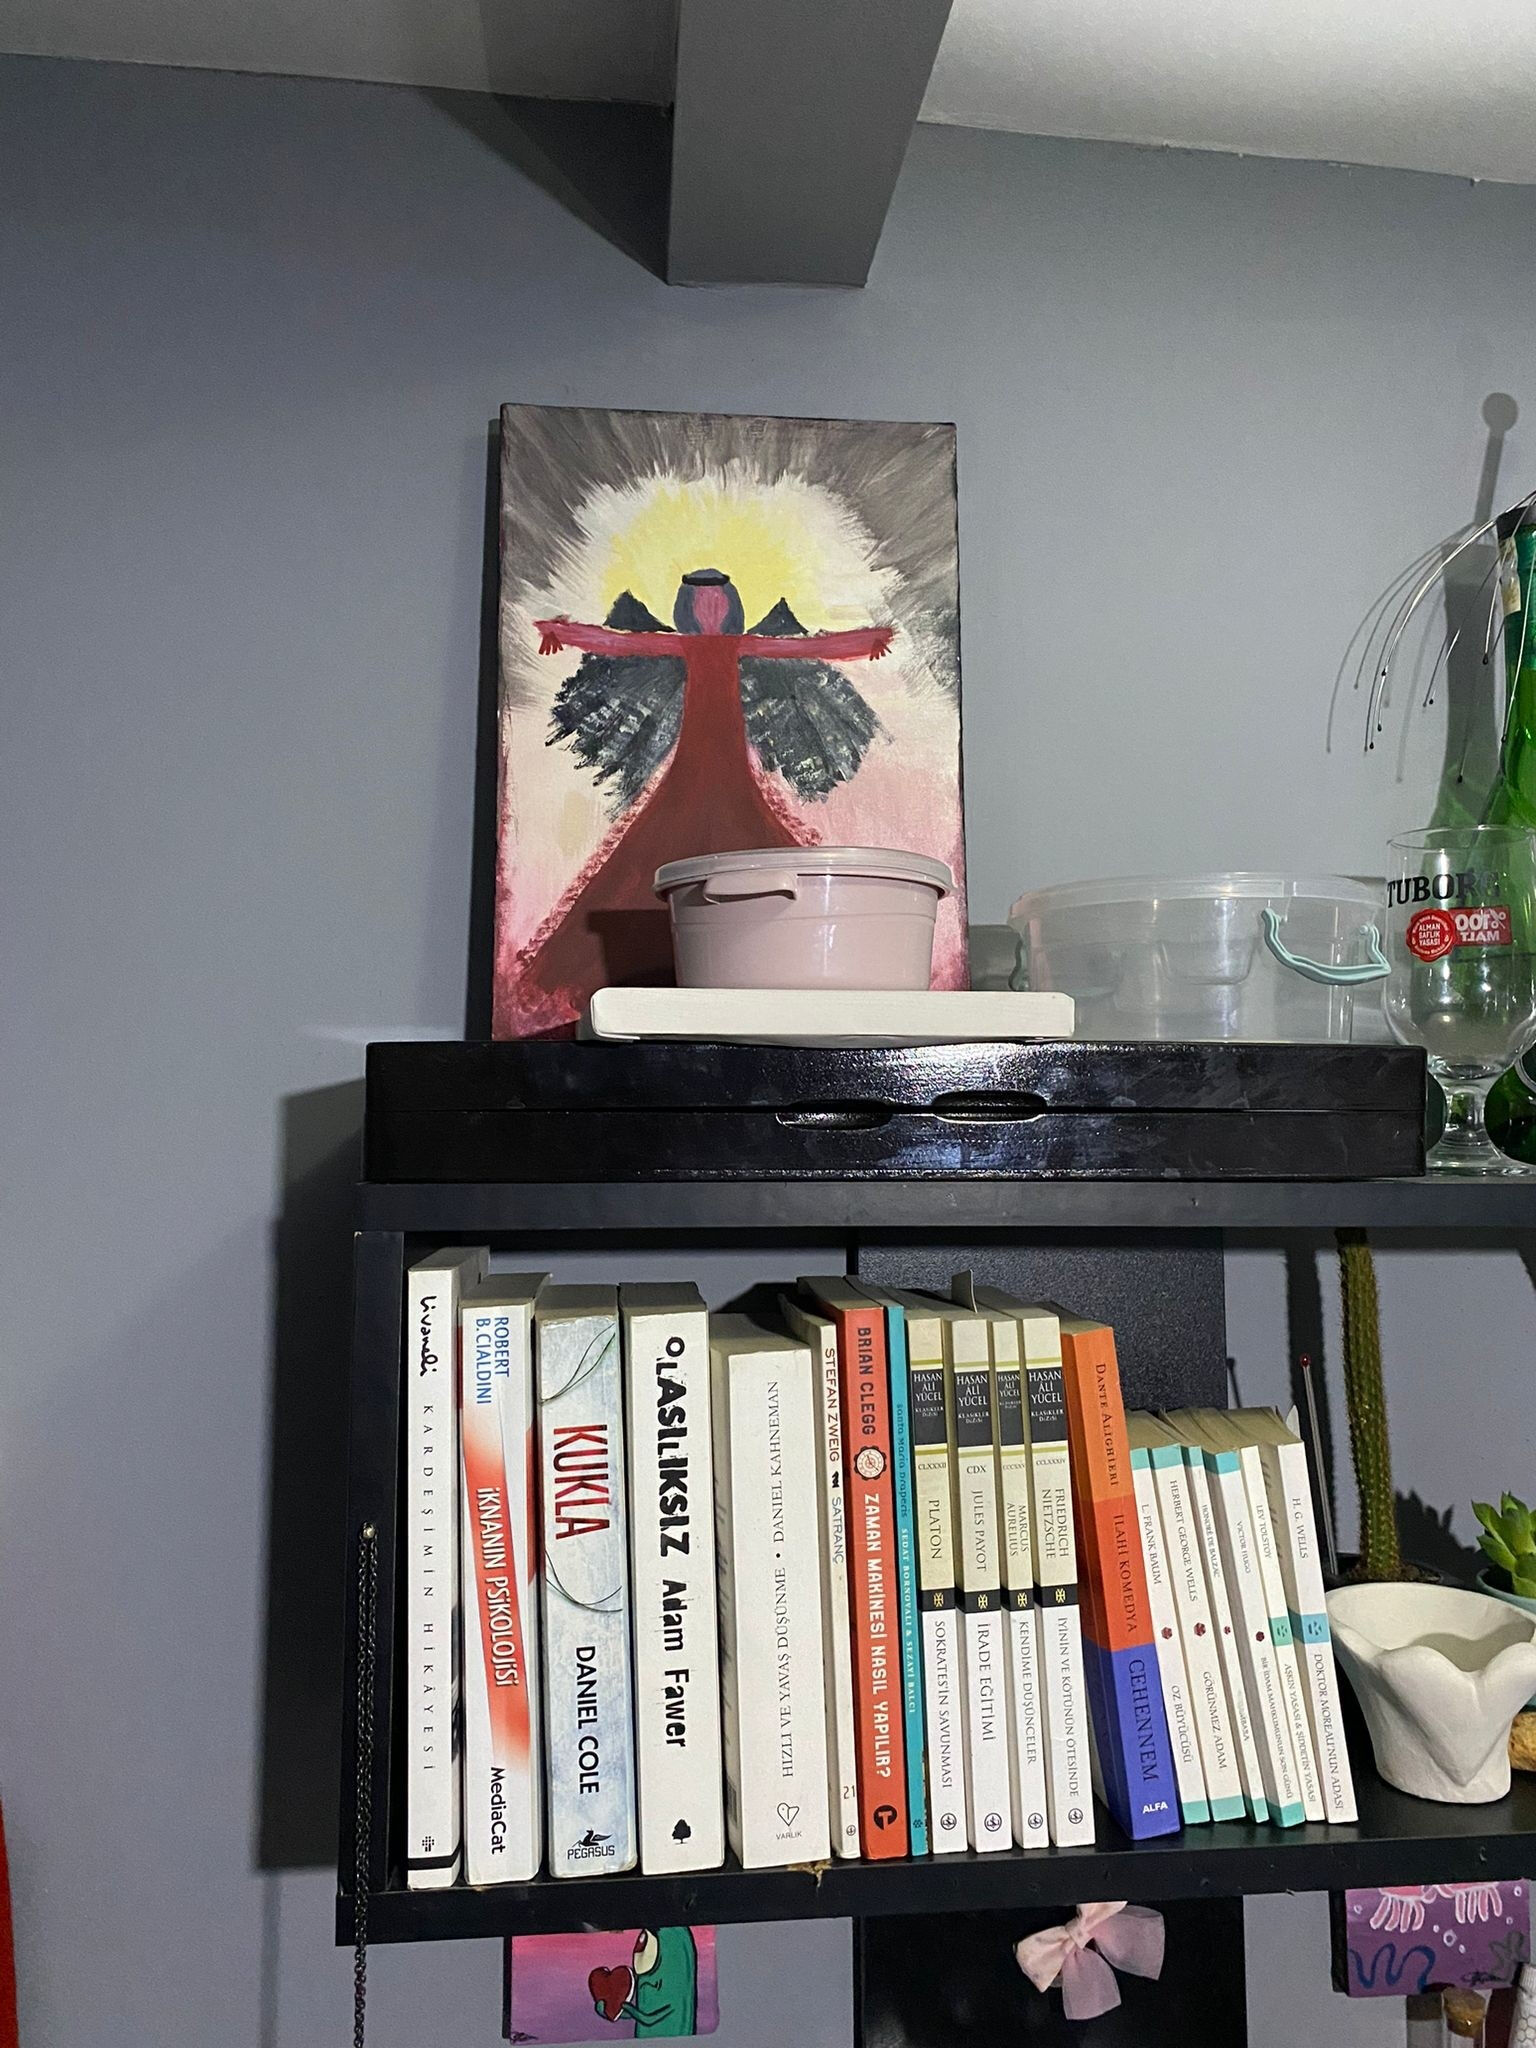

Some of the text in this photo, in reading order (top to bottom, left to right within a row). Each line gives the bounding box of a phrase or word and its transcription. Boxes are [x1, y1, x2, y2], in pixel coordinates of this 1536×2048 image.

[1387, 872, 1499, 908] TUBORG
[420, 1296, 438, 1376] Livaneli
[494, 1317, 509, 1377] ROBERT
[824, 1348, 840, 1462] STEFAN ZWEIG
[858, 1328, 875, 1436] BRIAN CLEGG
[914, 1372, 942, 1382] HASAN
[915, 1391, 942, 1402] YÜCEL
[956, 1374, 988, 1385] HASAN
[958, 1395, 987, 1407] YÜCEL
[998, 1374, 1020, 1382] HASAN
[1029, 1370, 1062, 1382] HASAN
[1031, 1392, 1062, 1404] YÜCEL
[656, 1337, 689, 1557] OLASILIKSIZ
[768, 1381, 785, 1543] DANIEL KAHNEMAN
[898, 1438, 908, 1468] Maria
[966, 1465, 987, 1474] CDX
[553, 1424, 610, 1540] KUKLA
[832, 1497, 844, 1564] SATRANÇ
[901, 1528, 910, 1562] SEDAT
[928, 1500, 942, 1559] PLATON
[972, 1490, 986, 1572] JULES PAYOT
[1007, 1502, 1018, 1556] AURELIUS
[1019, 1505, 1029, 1552] MARCUS
[1041, 1489, 1056, 1559] NIETZSCHE
[1055, 1488, 1069, 1557] FRIEDRICH
[1141, 1504, 1161, 1585] L. FRANK BAUM
[1170, 1480, 1197, 1601] HERBERT GEORGE WELLS
[1202, 1504, 1220, 1578] HONORÉ DE BALZAC
[1236, 1521, 1251, 1574] VICTOR HUGO
[1256, 1505, 1272, 1559] LEV TOLSTOY
[1292, 1498, 1308, 1559] H. G. WELLS
[422, 1405, 435, 1770] KARDEŞİMİN HİKÂYESİ
[902, 1565, 912, 1626] BORNOVALI
[1119, 1560, 1138, 1632] KOMEDYA
[662, 1580, 689, 1748] Adam Fawer
[864, 1493, 890, 1778] ZAMAN MAKİNESİ NASIL YAPILIR?
[906, 1641, 915, 1678] SEZAYİ
[1261, 1657, 1270, 1668] BİR
[774, 1568, 794, 1778] HIZLI VE YAVAŞ DÜŞÜNME
[908, 1682, 916, 1713] BALCI
[977, 1623, 996, 1742] İRADE EĞİTİMİ
[1019, 1621, 1037, 1764] KENDİME DÜŞÜNCELER
[1263, 1670, 1273, 1692] İDAM
[1284, 1664, 1295, 1689] AŞKIN
[576, 1646, 599, 1794] DANIEL COLE
[934, 1620, 952, 1788] SOKRATES'İN SAVUNMASI
[1057, 1618, 1079, 1797] İYİNİN VE KÖTÜNÜN ÖTESİNDE
[1128, 1659, 1159, 1782] CEHENNEM
[1172, 1686, 1193, 1763] OZ BÜYÜCÜSÜ
[1203, 1672, 1227, 1769] GÖRÜNMEZ ADAM
[1290, 1691, 1301, 1720] YASASI
[1314, 1654, 1344, 1809] DOKTOR MOREAU'NUN ADASI
[1280, 1757, 1288, 1773] SON
[1295, 1731, 1312, 1770] ŞİDDETİN
[490, 1767, 506, 1854] MediaCat
[1142, 1802, 1168, 1814] ALFA
[1283, 1774, 1293, 1799] GÜNÜ
[1304, 1773, 1316, 1802] YASASI
[566, 1845, 615, 1860] PEGASUS
[776, 1830, 803, 1840] VARLIK
